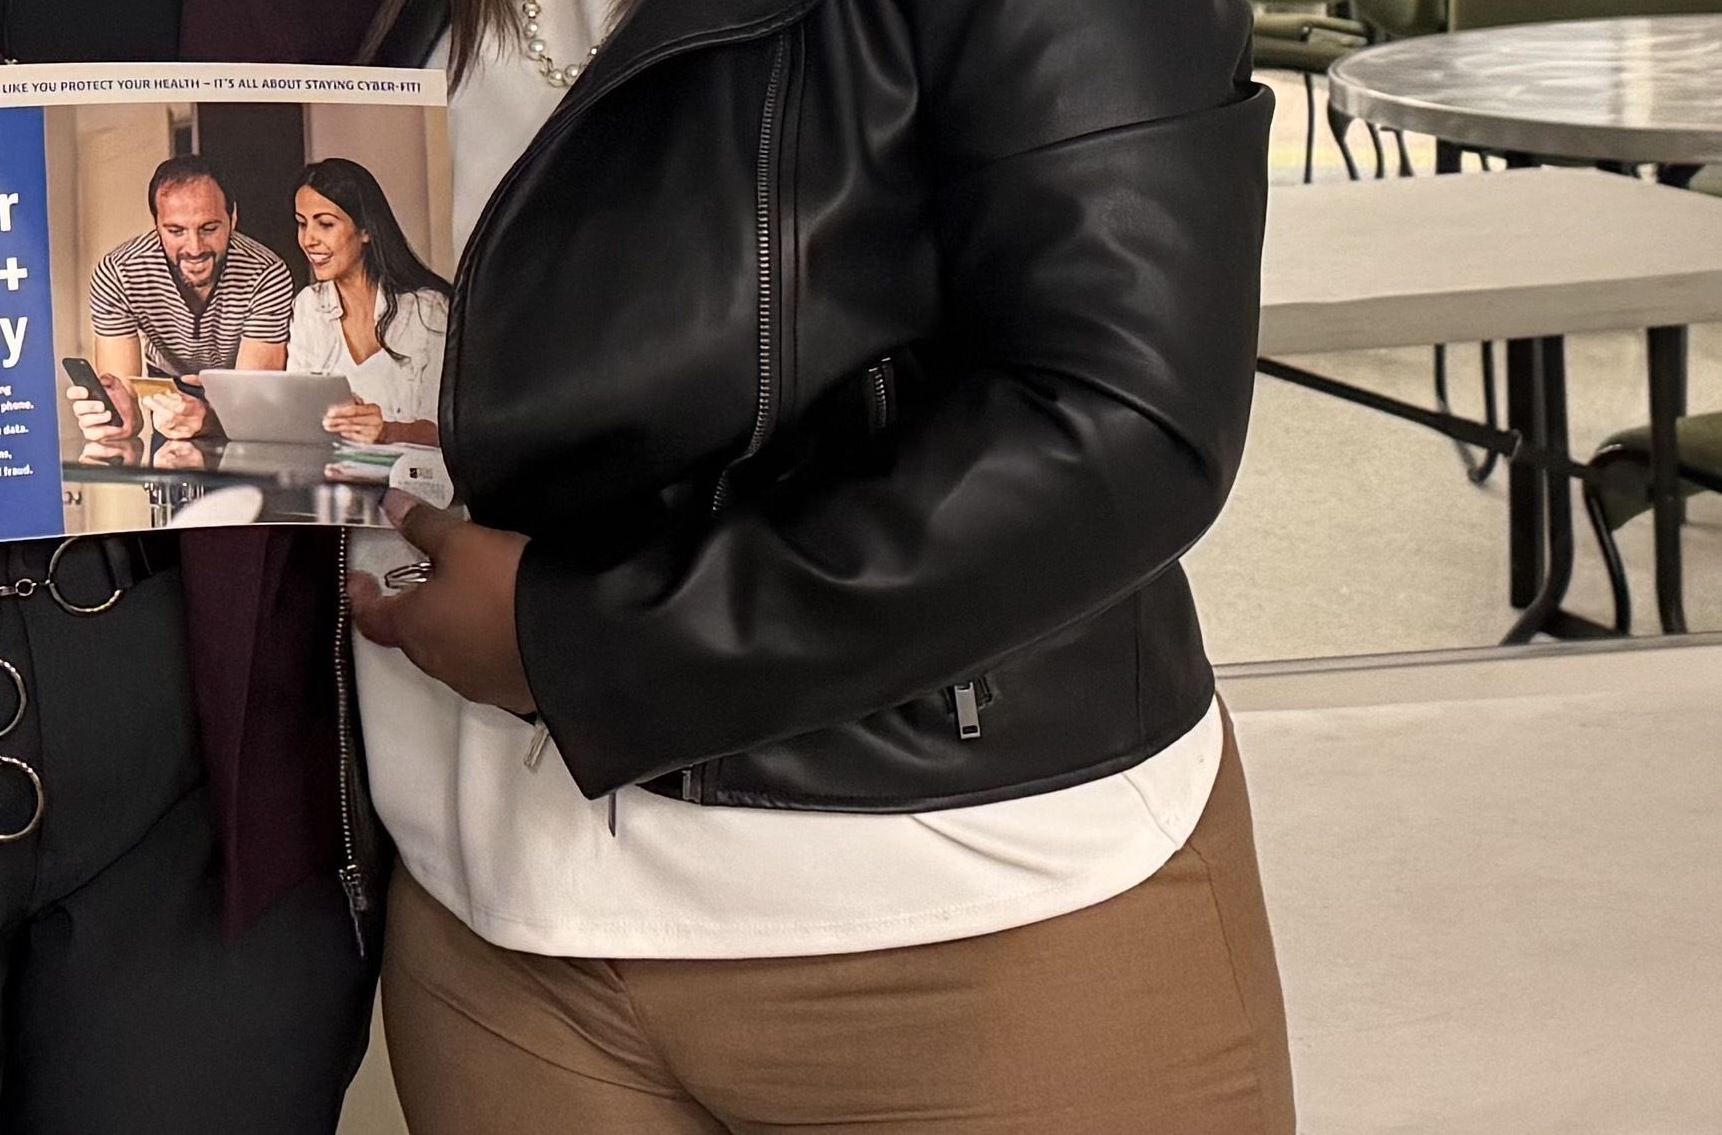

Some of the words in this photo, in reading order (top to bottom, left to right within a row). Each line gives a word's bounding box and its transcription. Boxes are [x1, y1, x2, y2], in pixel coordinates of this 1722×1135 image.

[2, 82, 29, 94] LIKE
[31, 81, 57, 92] YOU
[60, 80, 113, 92] PROTECT
[117, 79, 151, 90] YOUR
[154, 79, 200, 89] HEALTH
[213, 79, 235, 89] IT'S
[238, 78, 258, 89] ALL
[262, 78, 302, 90] ABOUT
[304, 79, 355, 91] STAYING
[0, 400, 35, 414] phone.
[3, 424, 30, 435] data.
[3, 463, 34, 477] fraud.
